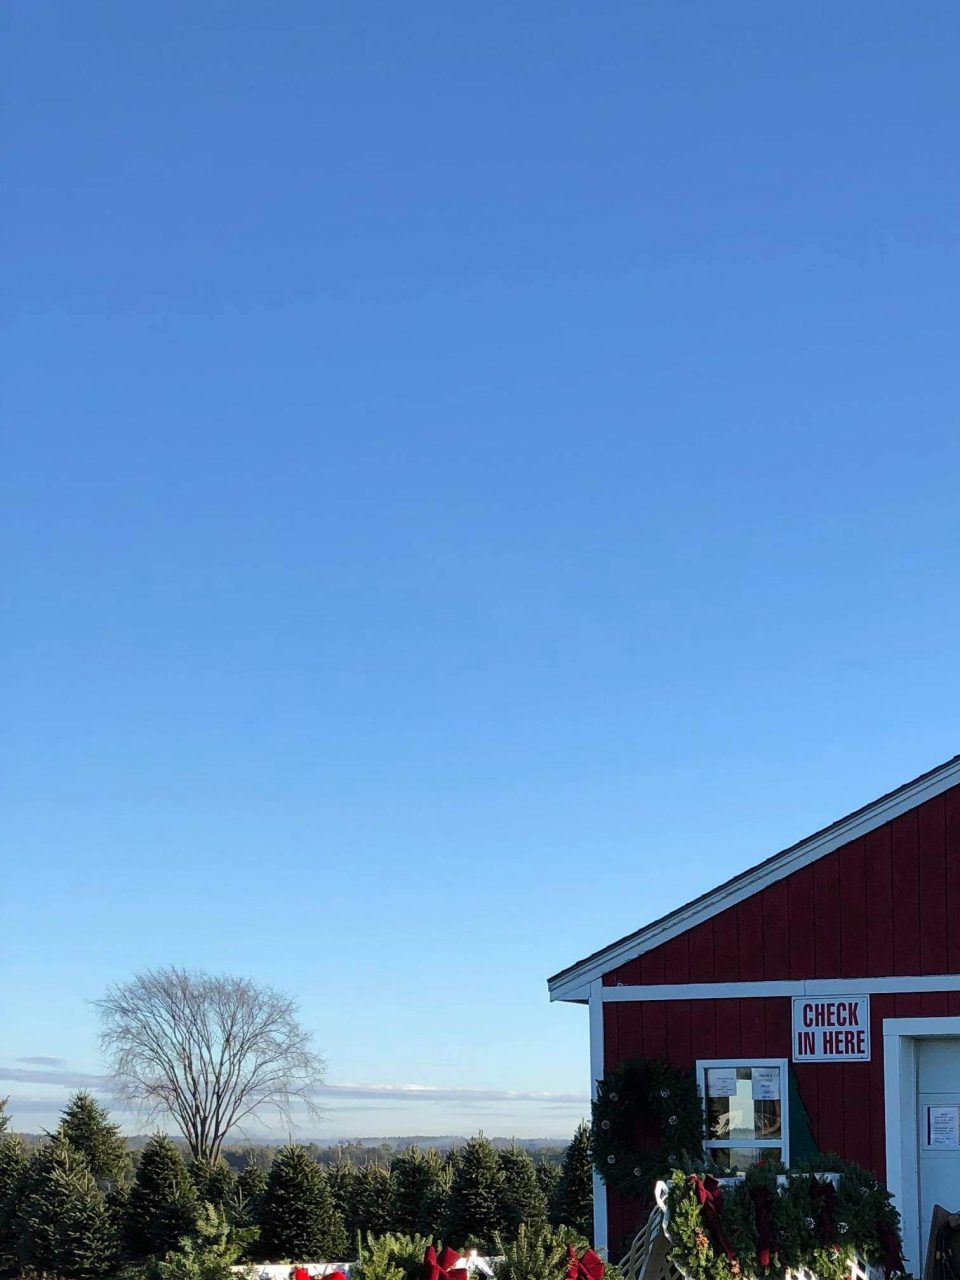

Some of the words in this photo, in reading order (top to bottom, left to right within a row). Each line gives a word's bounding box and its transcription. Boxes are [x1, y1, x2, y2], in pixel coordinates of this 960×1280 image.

[803, 1002, 859, 1028] CHECK
[798, 1031, 815, 1055] IN
[823, 1030, 865, 1054] HERE
